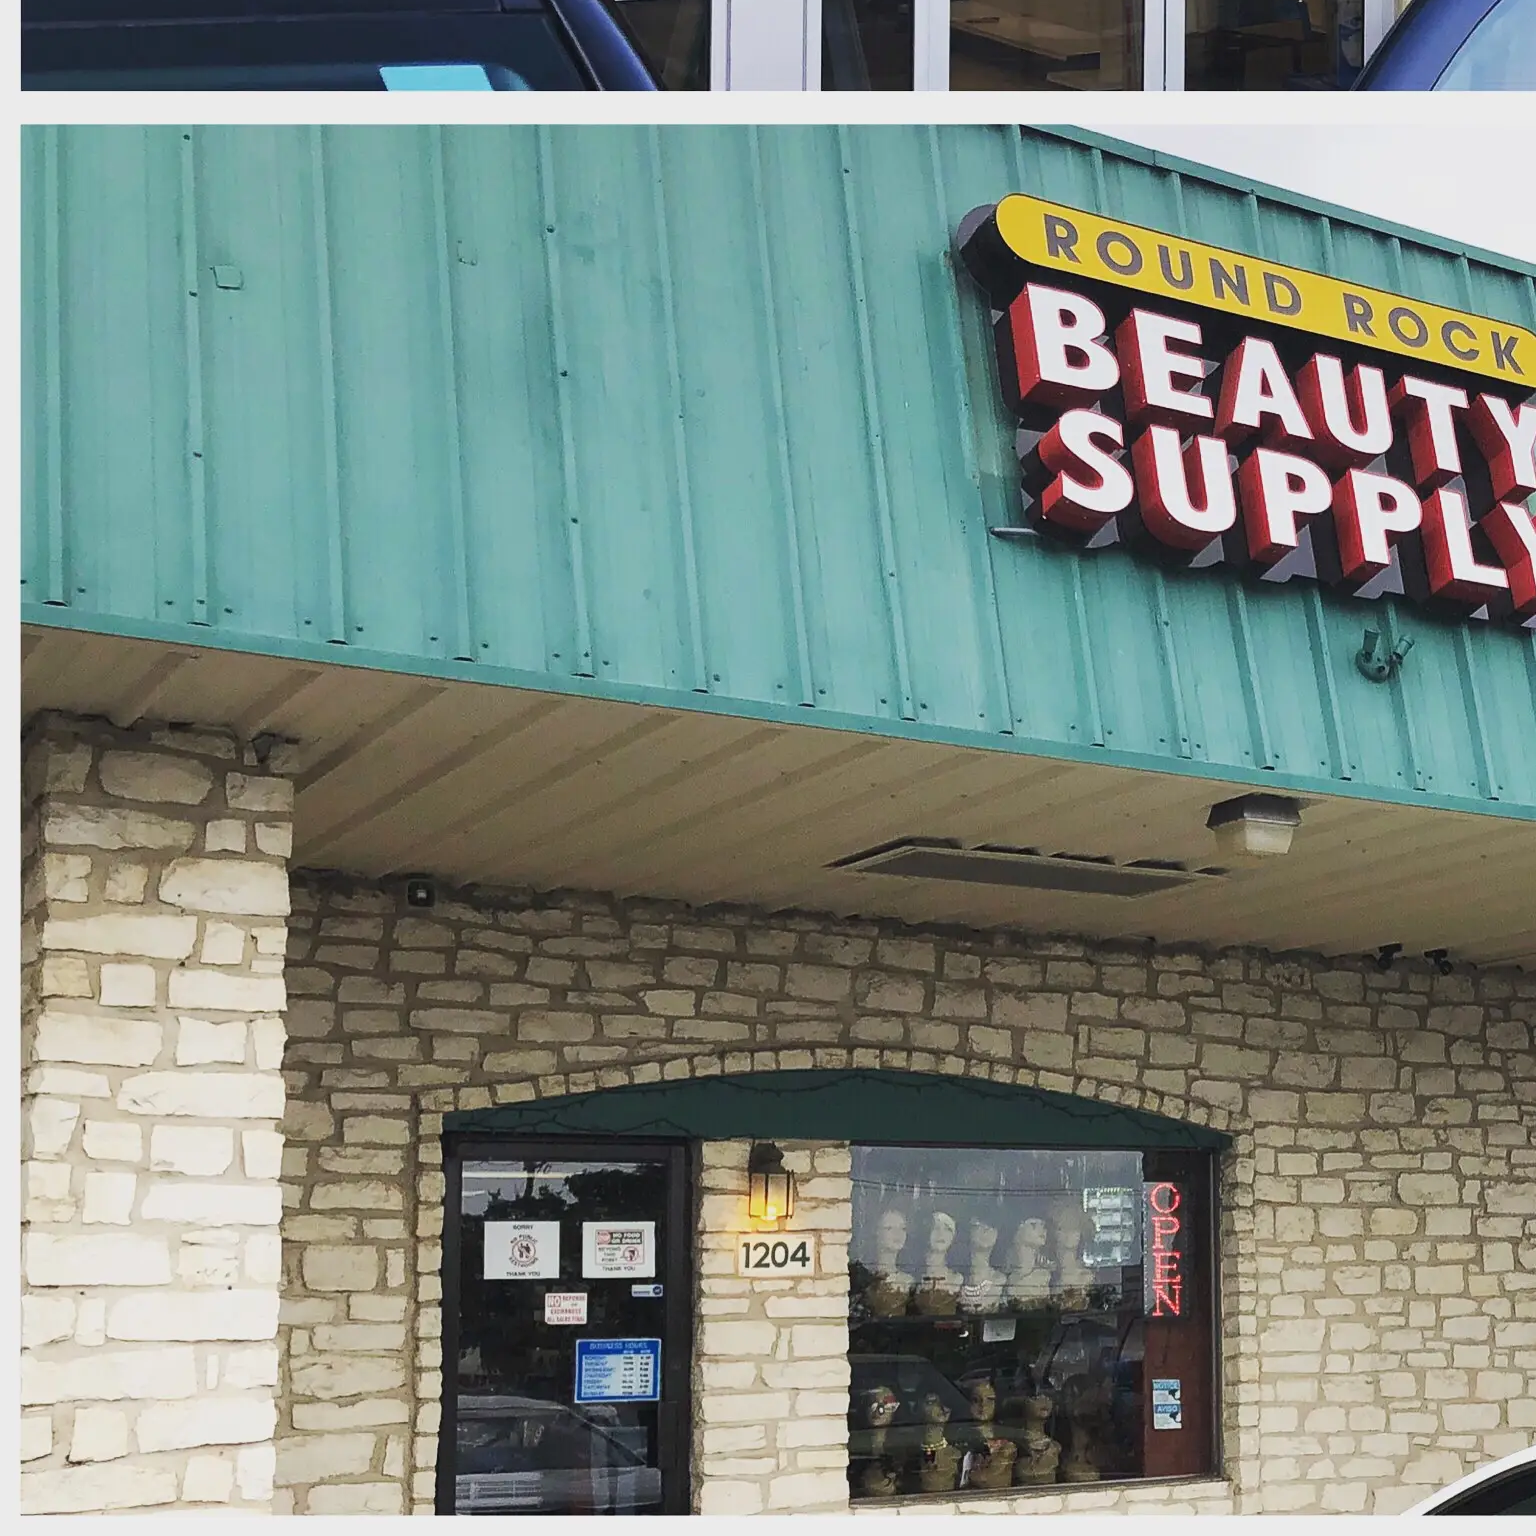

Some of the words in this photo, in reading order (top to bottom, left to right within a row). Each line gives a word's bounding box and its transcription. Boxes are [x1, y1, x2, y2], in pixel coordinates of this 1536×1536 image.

[1043, 213, 1302, 317] ROUND
[1343, 292, 1524, 376] ROCK
[741, 1241, 811, 1269] 1204
[1149, 1183, 1183, 1317] OPEN
